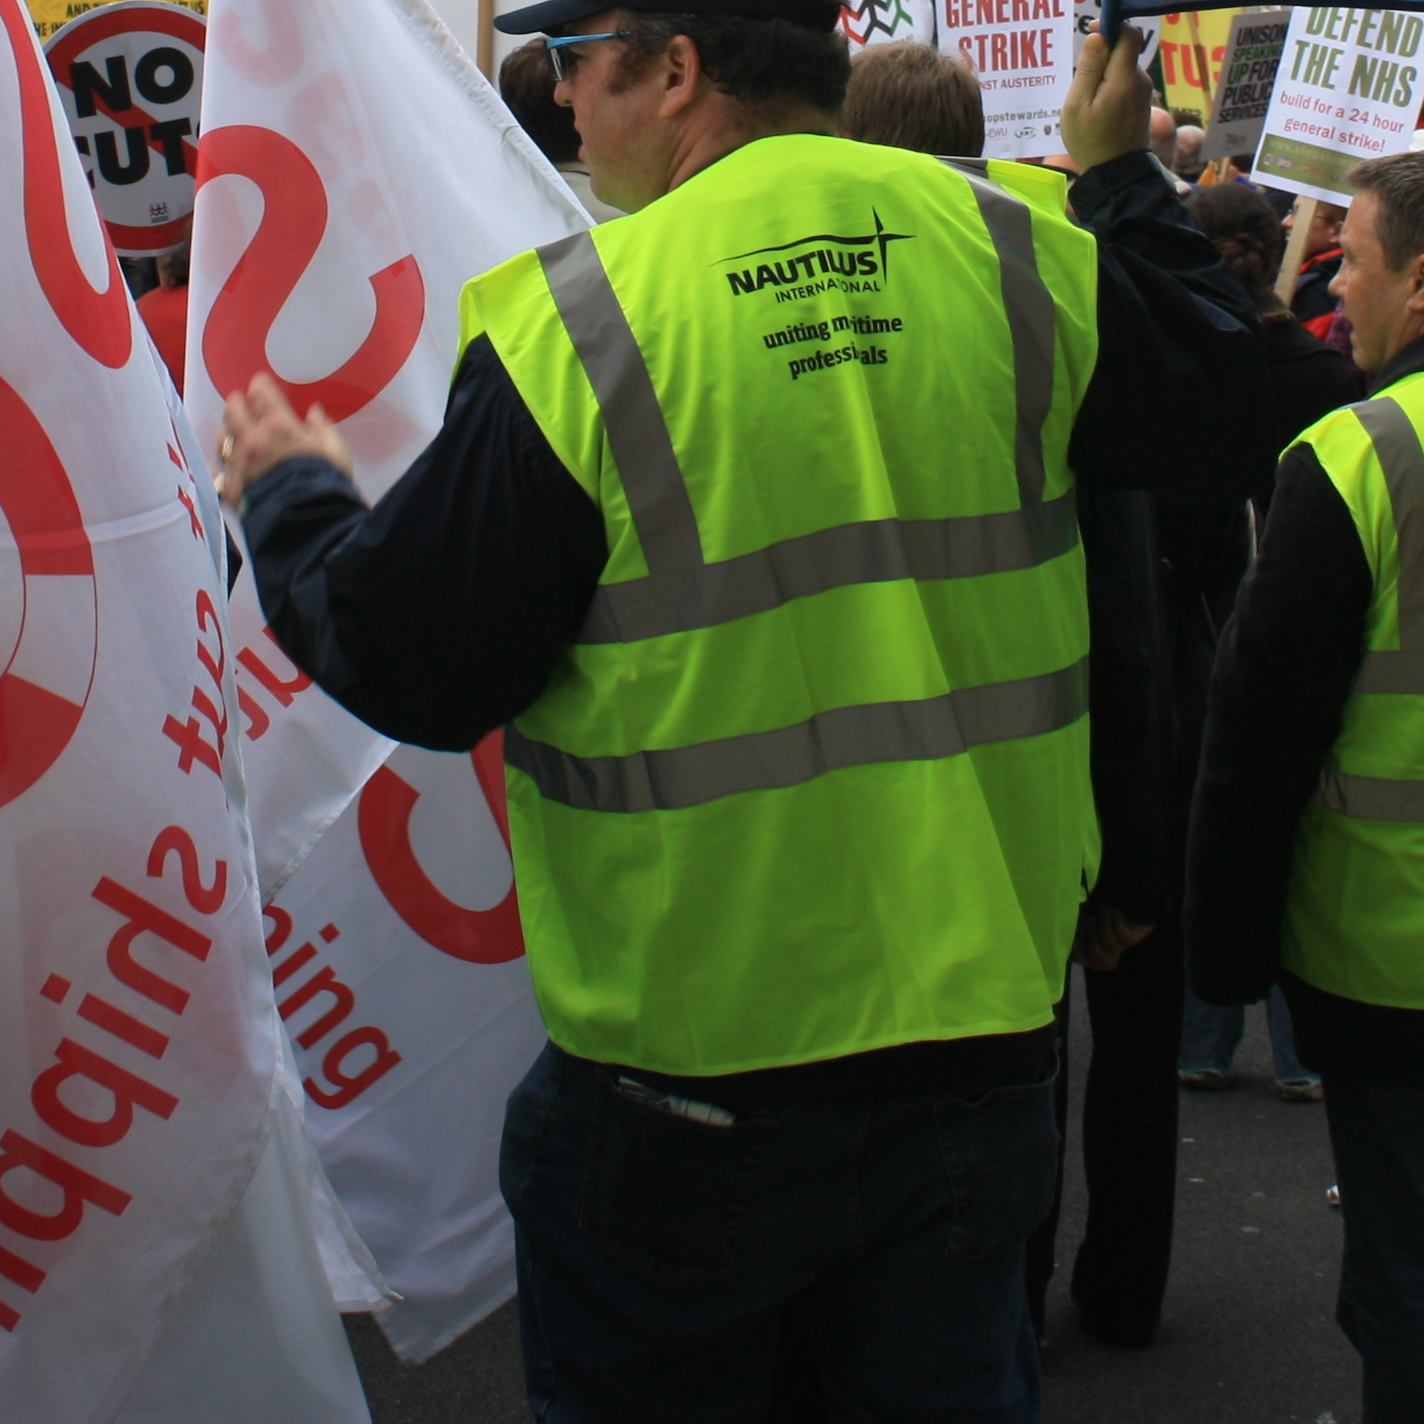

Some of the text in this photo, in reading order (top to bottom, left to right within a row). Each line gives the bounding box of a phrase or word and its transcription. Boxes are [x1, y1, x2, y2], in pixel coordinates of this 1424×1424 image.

[958, 28, 1054, 72] STRIKE
[1305, 7, 1424, 58] DEFEND
[69, 47, 194, 119] NO
[1000, 75, 1057, 89] AUSTERITY
[1227, 63, 1249, 85] UP
[1290, 40, 1418, 108] THE NHS
[1280, 91, 1405, 133] build for a 24 hour
[1284, 117, 1335, 140] general
[1338, 131, 1386, 153] strike!
[726, 250, 878, 296] NAUTILUS
[762, 320, 831, 349] uniting
